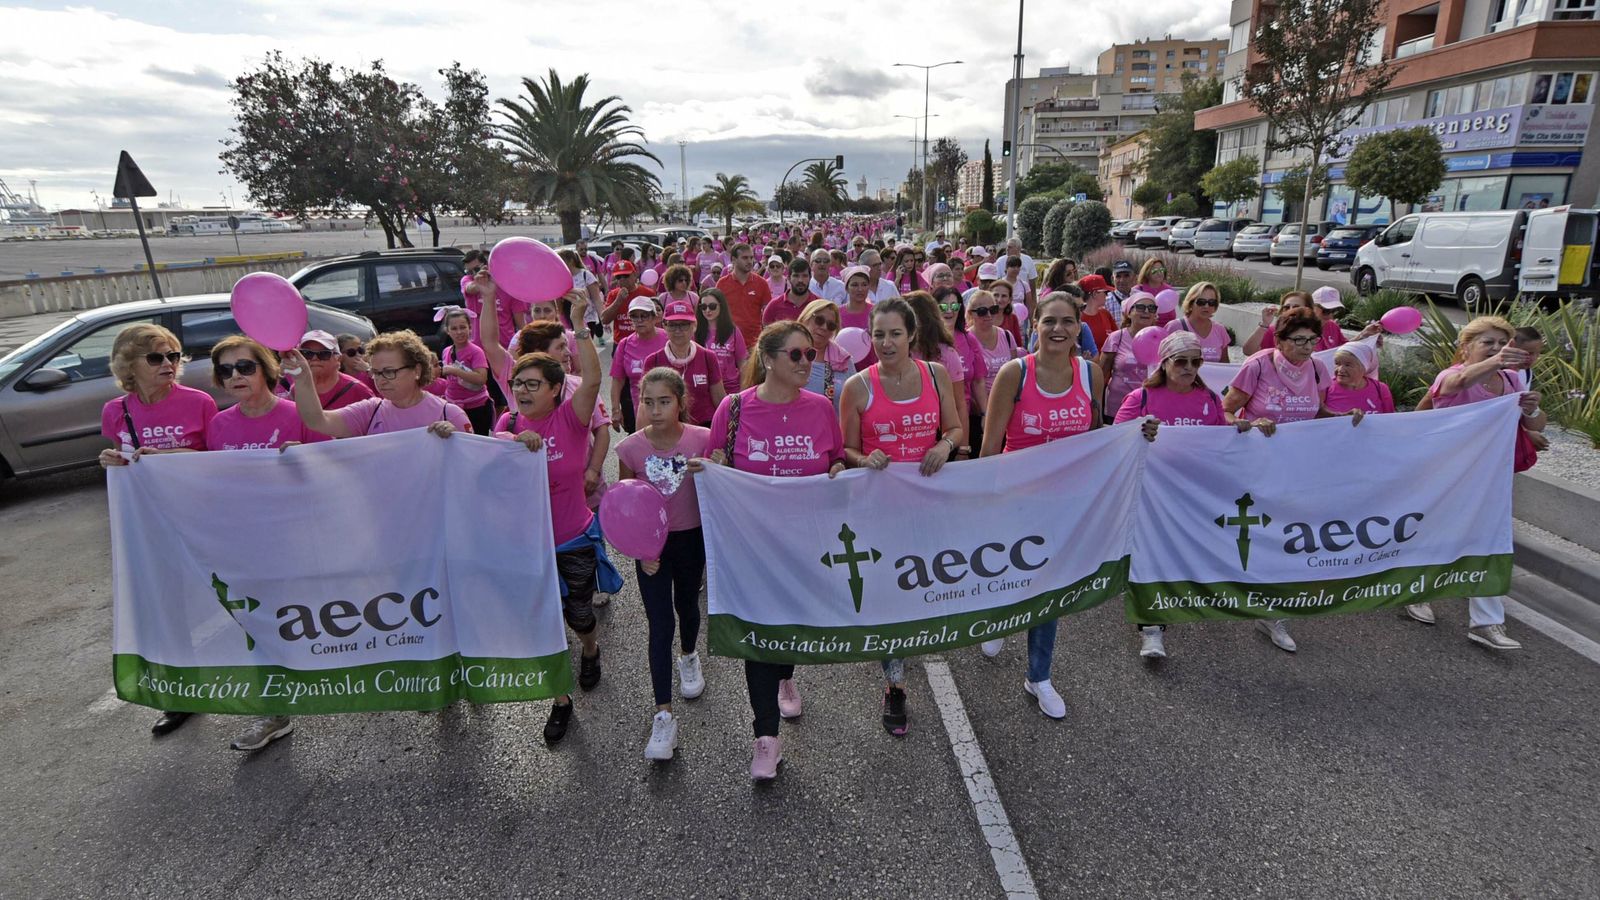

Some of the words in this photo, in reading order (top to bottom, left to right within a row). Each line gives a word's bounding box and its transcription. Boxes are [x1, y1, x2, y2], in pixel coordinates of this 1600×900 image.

[1285, 395, 1311, 403] aecc
[902, 412, 937, 426] aecc
[1049, 406, 1087, 420] aecc
[1174, 417, 1203, 426] aecc
[142, 425, 184, 438] aecc
[774, 435, 811, 447] aecc
[242, 442, 273, 451] aecc
[908, 446, 926, 454] aecc
[1283, 512, 1425, 555] aecc
[895, 534, 1050, 591] aecc
[1307, 555, 1349, 569] Contra
[1354, 553, 1364, 566] el
[1368, 547, 1400, 566] Cáncer
[924, 586, 966, 604] Contra
[971, 583, 981, 596] el
[987, 575, 1033, 592] Cáncer
[1147, 590, 1239, 612] Asociación
[1245, 588, 1335, 613] Española
[1343, 577, 1402, 601] Contra
[1409, 575, 1426, 595] el
[1432, 568, 1487, 591] Cáncer
[276, 586, 443, 642] aecc
[310, 640, 359, 656] Contra
[365, 636, 377, 651] el
[385, 631, 425, 648] Cáncer
[739, 629, 852, 654] Asociación
[862, 624, 958, 656] Española
[968, 611, 1032, 639] Contra
[138, 668, 251, 700] Asociación
[259, 672, 367, 704] Española
[374, 669, 442, 694] Contra
[449, 664, 466, 688] el
[466, 664, 548, 690] Cáncer
